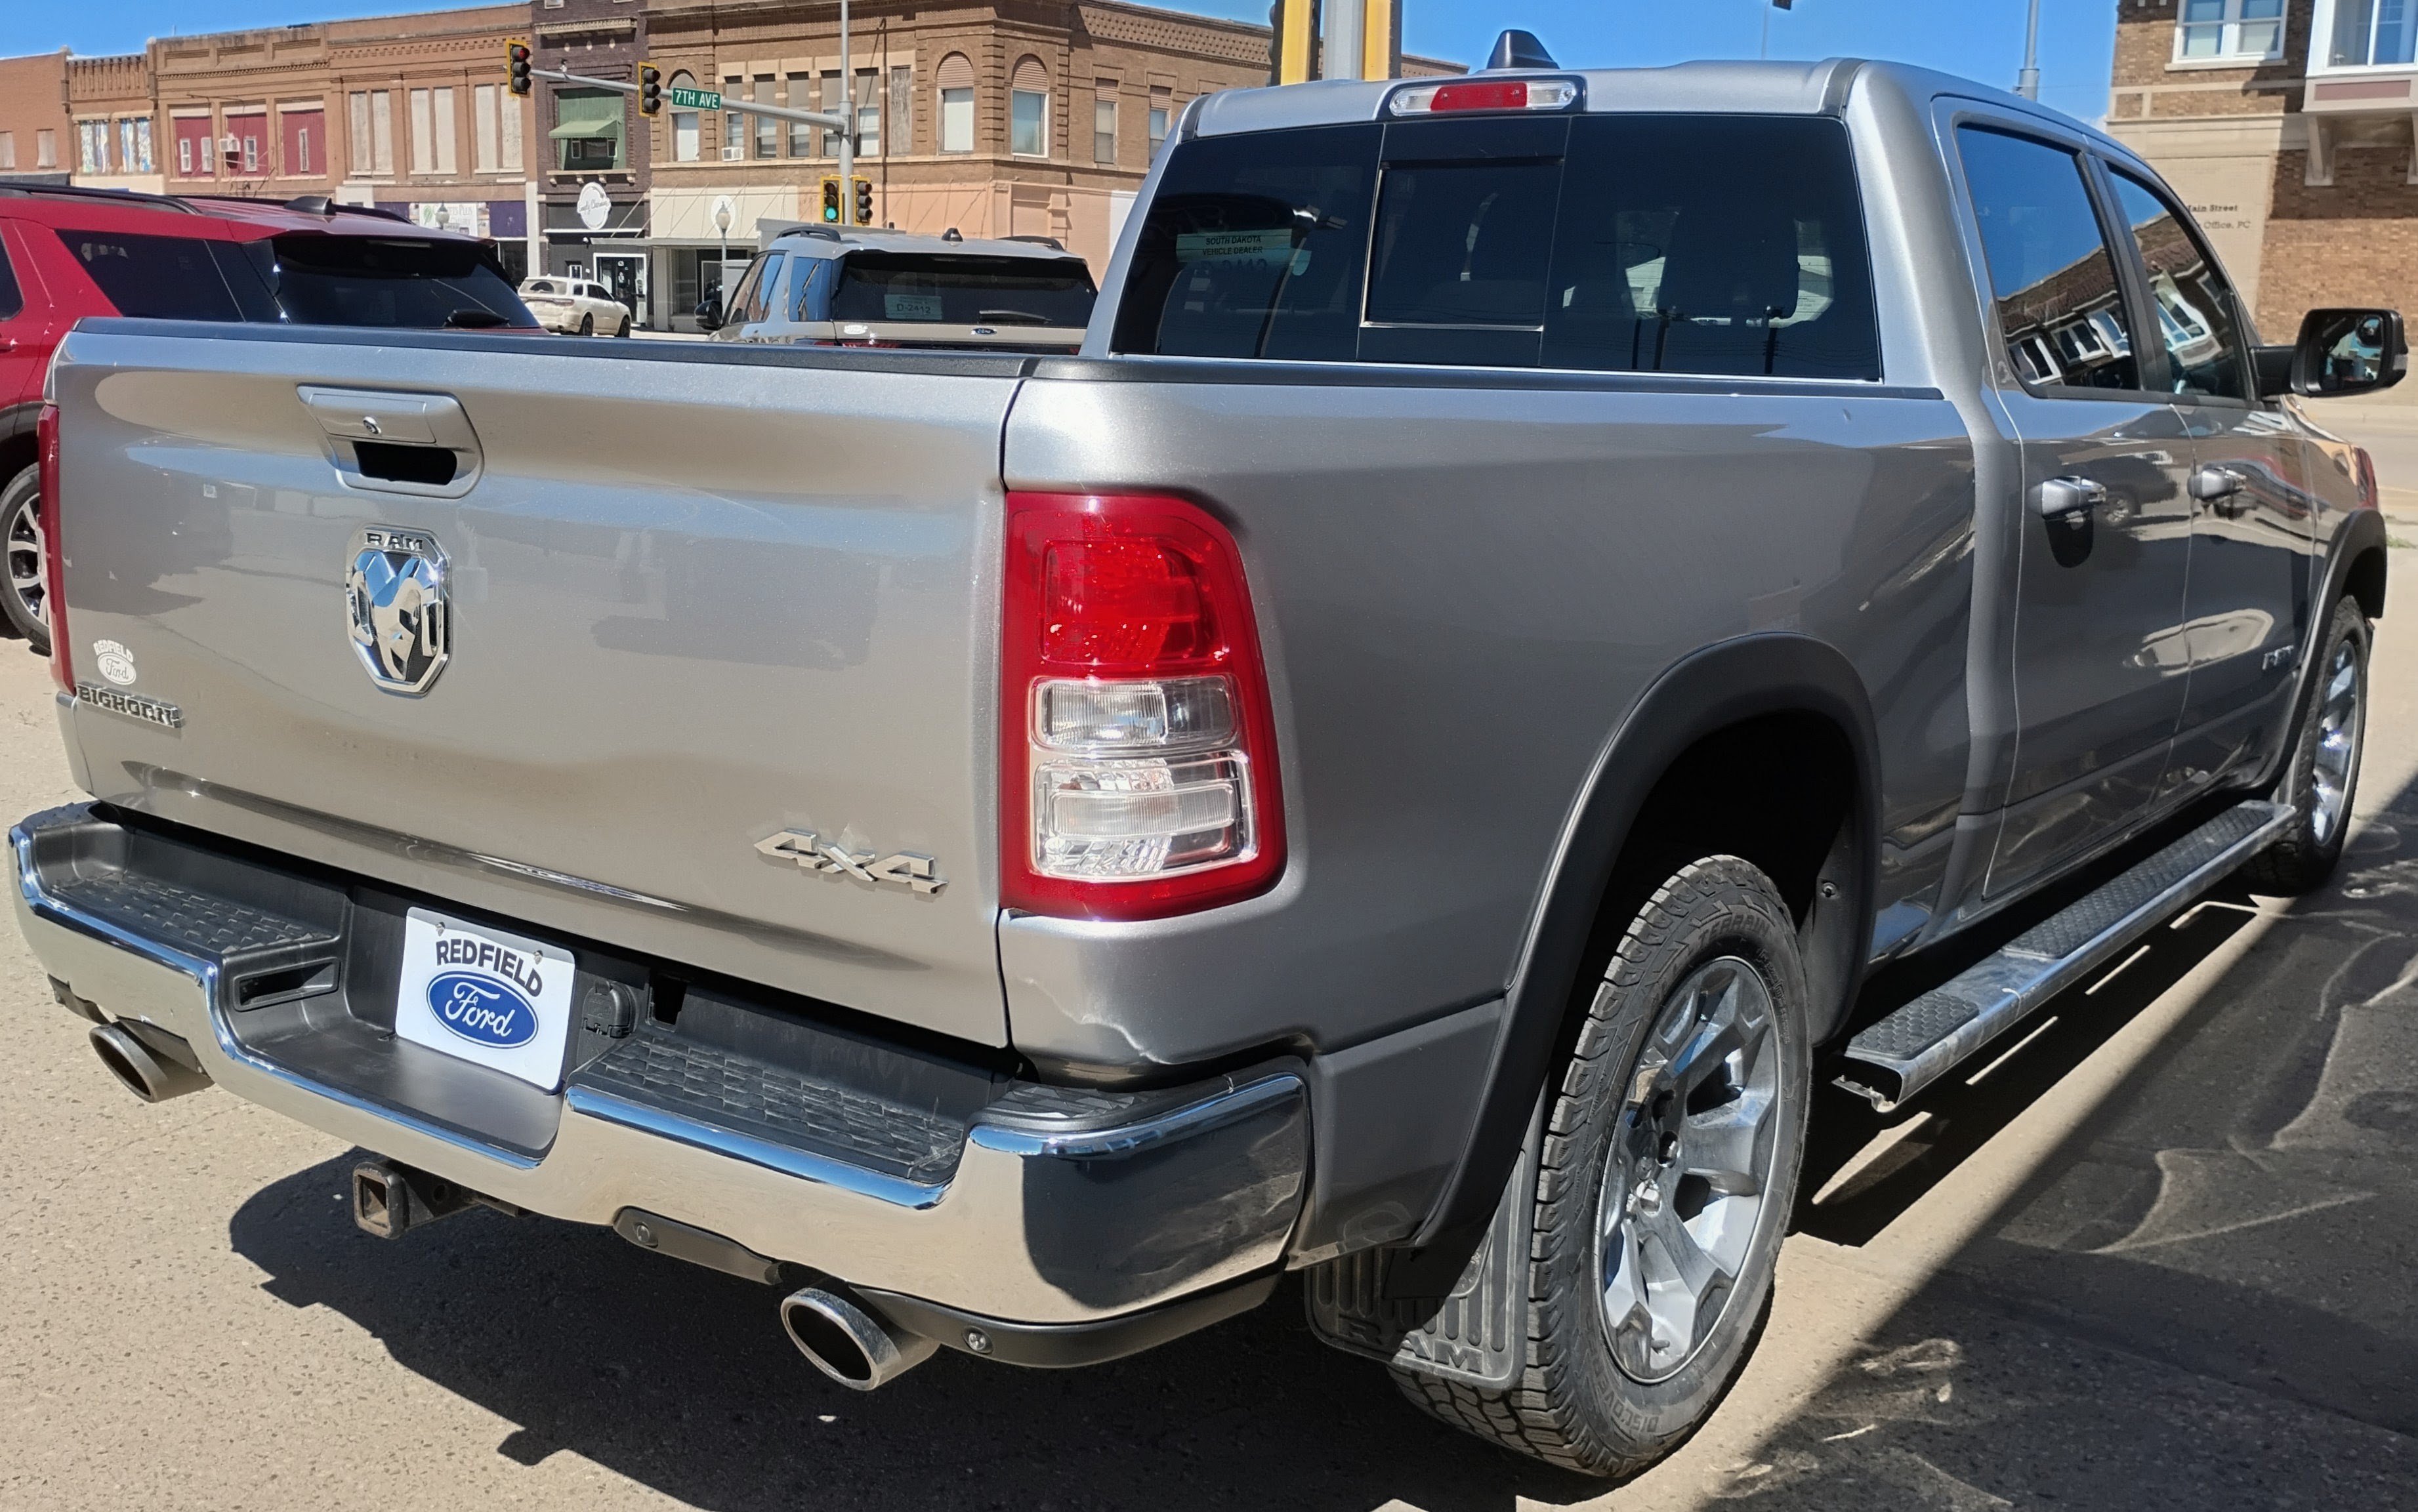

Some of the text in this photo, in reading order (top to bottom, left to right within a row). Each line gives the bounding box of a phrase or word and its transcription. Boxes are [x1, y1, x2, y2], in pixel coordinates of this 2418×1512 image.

[675, 89, 719, 108] 7TH AVE
[1202, 246, 1263, 256] VEHICLE DEALER
[1205, 235, 1262, 245] SOUTH DAKOTA
[365, 533, 423, 550] RAM
[93, 639, 134, 663] REDFIELD
[105, 657, 129, 680] Ford
[77, 684, 177, 728] BIGHORN
[436, 938, 543, 998] REDFIELD
[445, 981, 516, 1037] Ford
